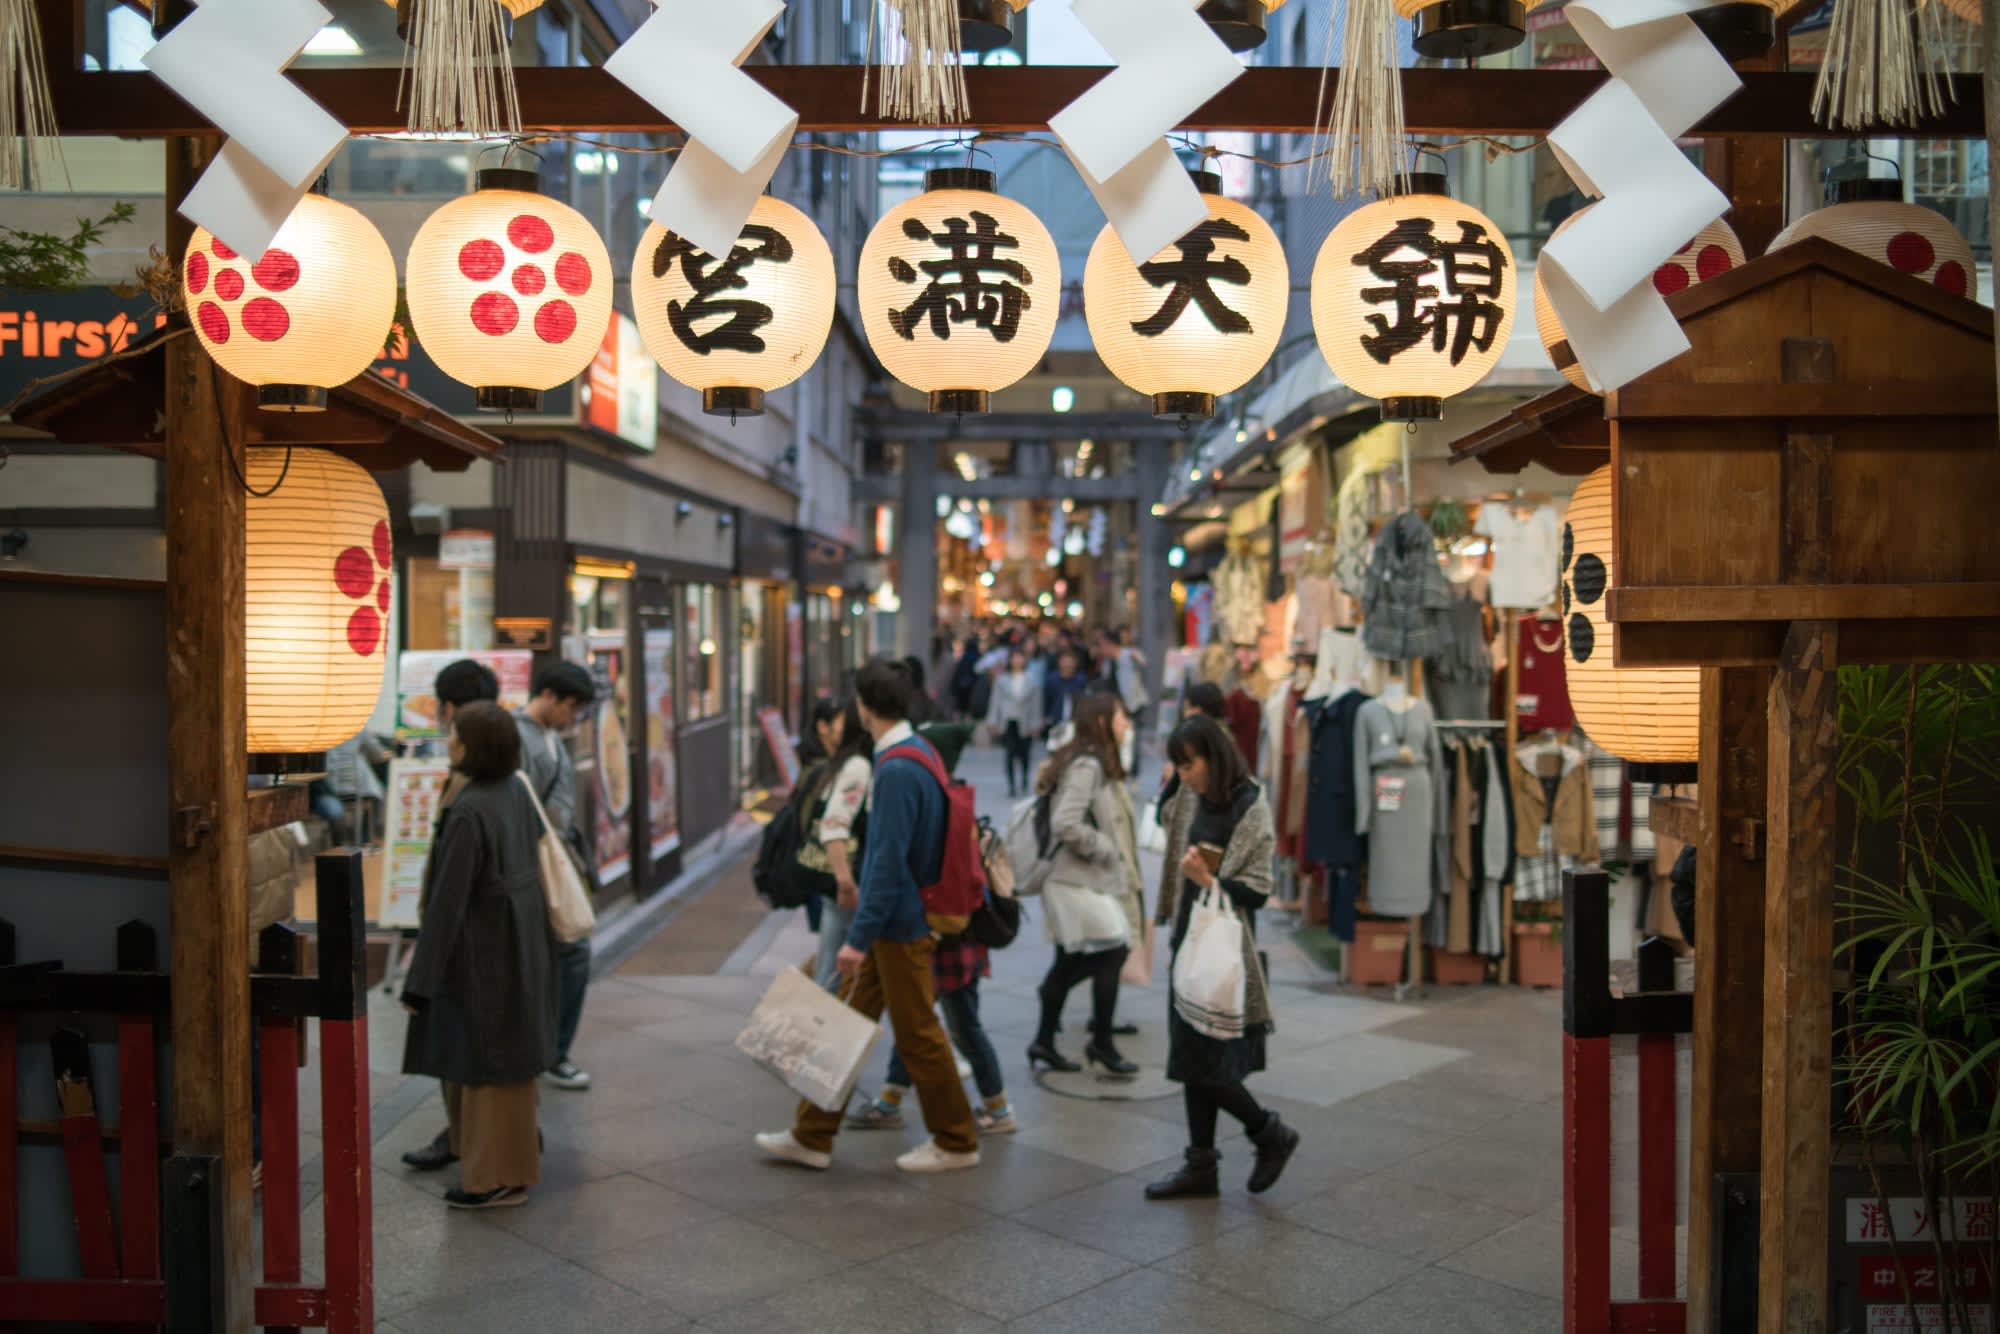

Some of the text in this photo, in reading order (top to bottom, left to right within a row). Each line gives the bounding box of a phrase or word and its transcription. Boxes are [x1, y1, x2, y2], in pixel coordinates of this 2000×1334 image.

[0, 310, 138, 358] First
[888, 211, 1032, 342] 満
[1130, 218, 1254, 336] 天
[1351, 217, 1506, 366] 錦
